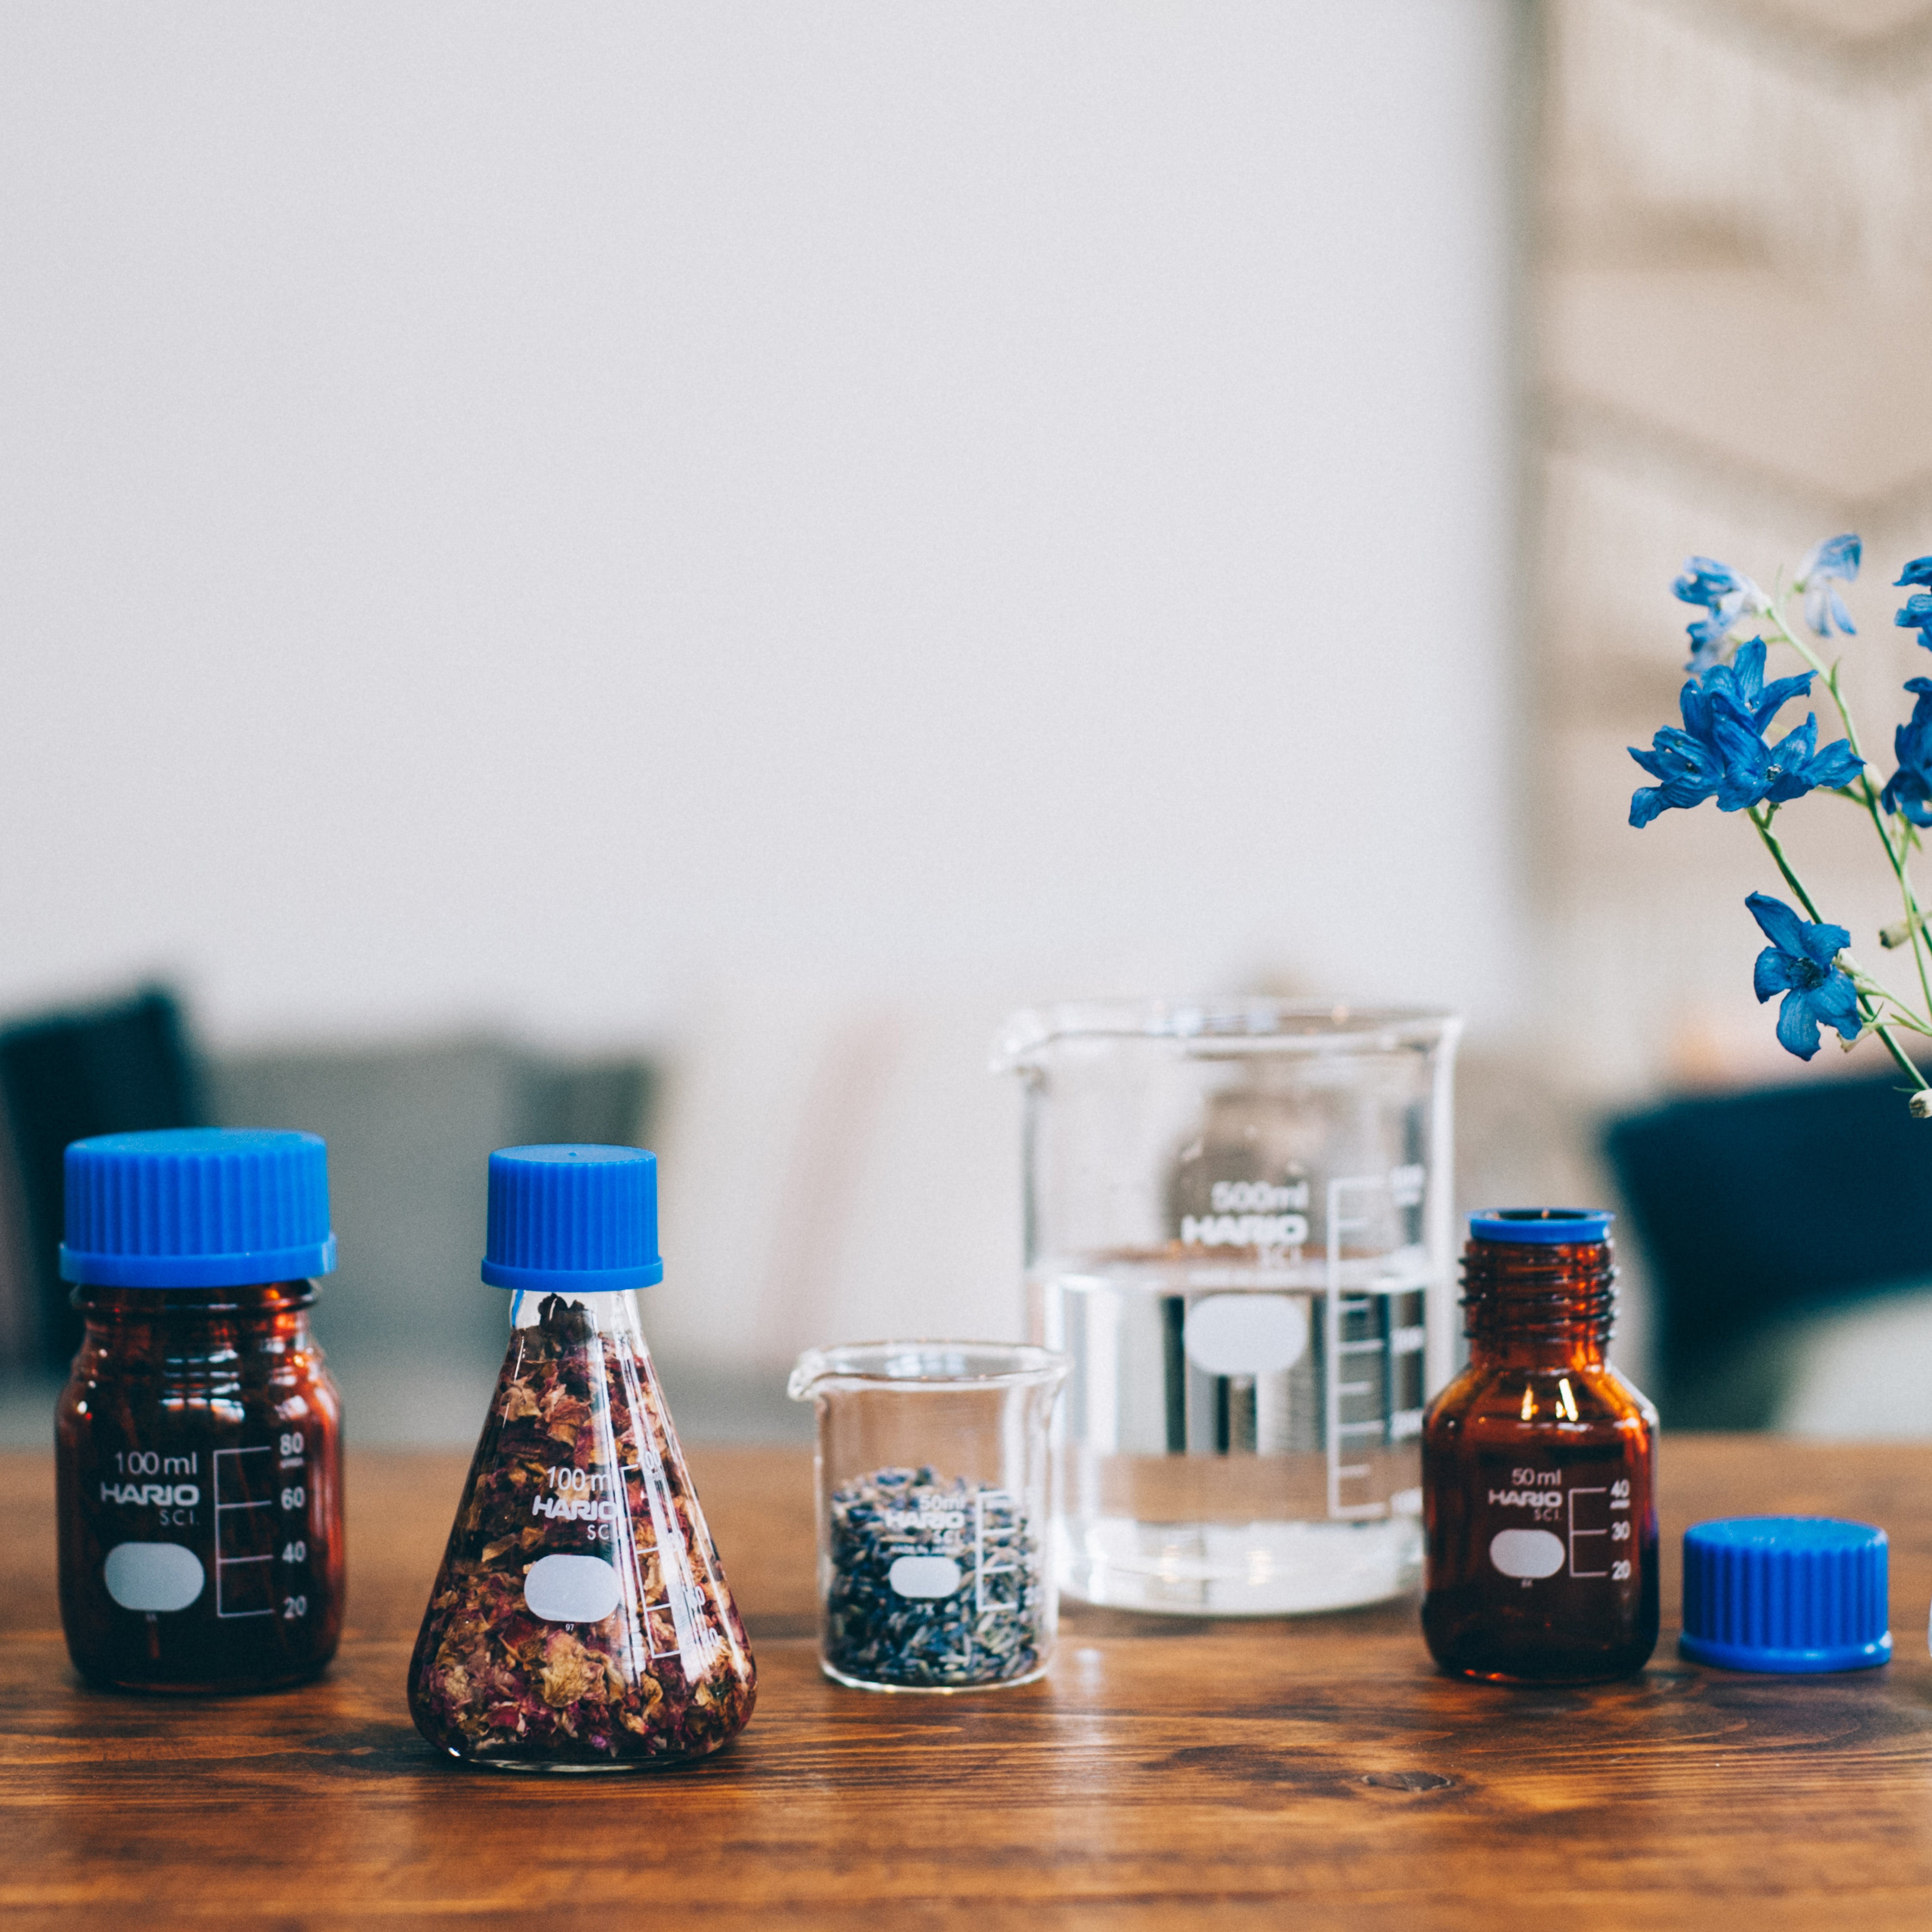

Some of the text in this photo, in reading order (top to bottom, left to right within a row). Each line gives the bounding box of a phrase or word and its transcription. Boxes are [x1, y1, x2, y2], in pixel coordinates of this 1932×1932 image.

[280, 1432, 304, 1455] 80
[100, 1482, 200, 1506] HARIO
[281, 1487, 305, 1510] 60
[1488, 1489, 1563, 1507] HARIO
[1610, 1479, 1631, 1498] 40
[532, 1495, 618, 1521] HARIO
[1611, 1520, 1631, 1541] 30
[282, 1541, 306, 1563] 40
[1612, 1559, 1632, 1581] 20
[283, 1595, 307, 1618] 20
